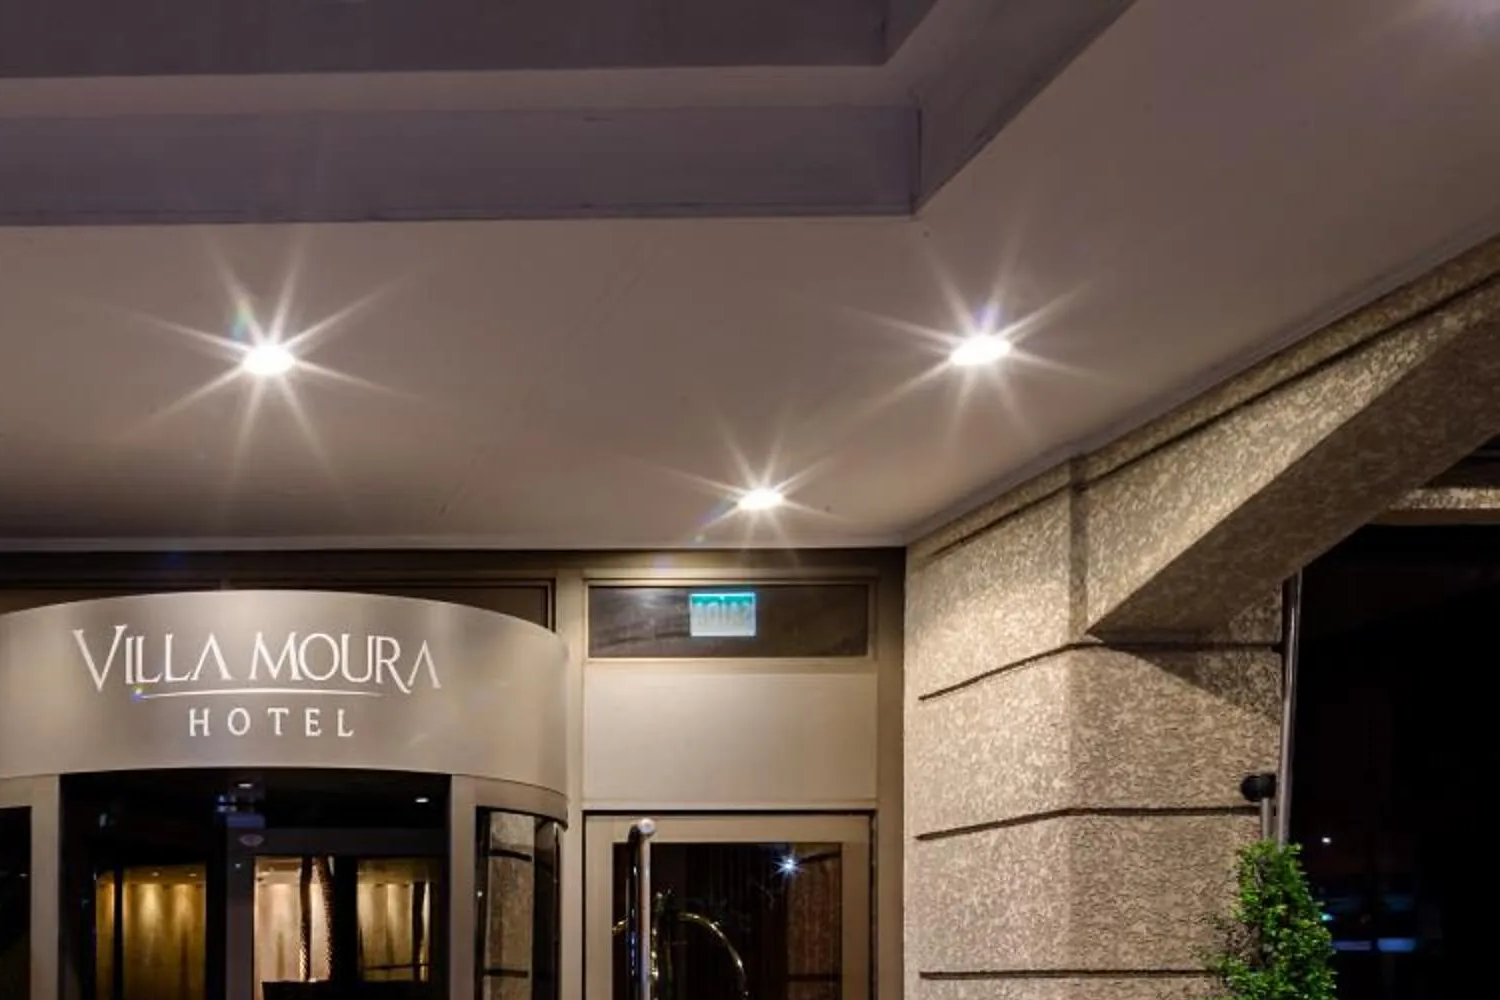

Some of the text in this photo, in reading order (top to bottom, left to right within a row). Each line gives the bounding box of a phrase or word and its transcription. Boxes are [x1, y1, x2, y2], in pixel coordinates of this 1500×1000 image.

[73, 624, 442, 693] VILLA MOURA
[188, 707, 354, 737] HOTEL
